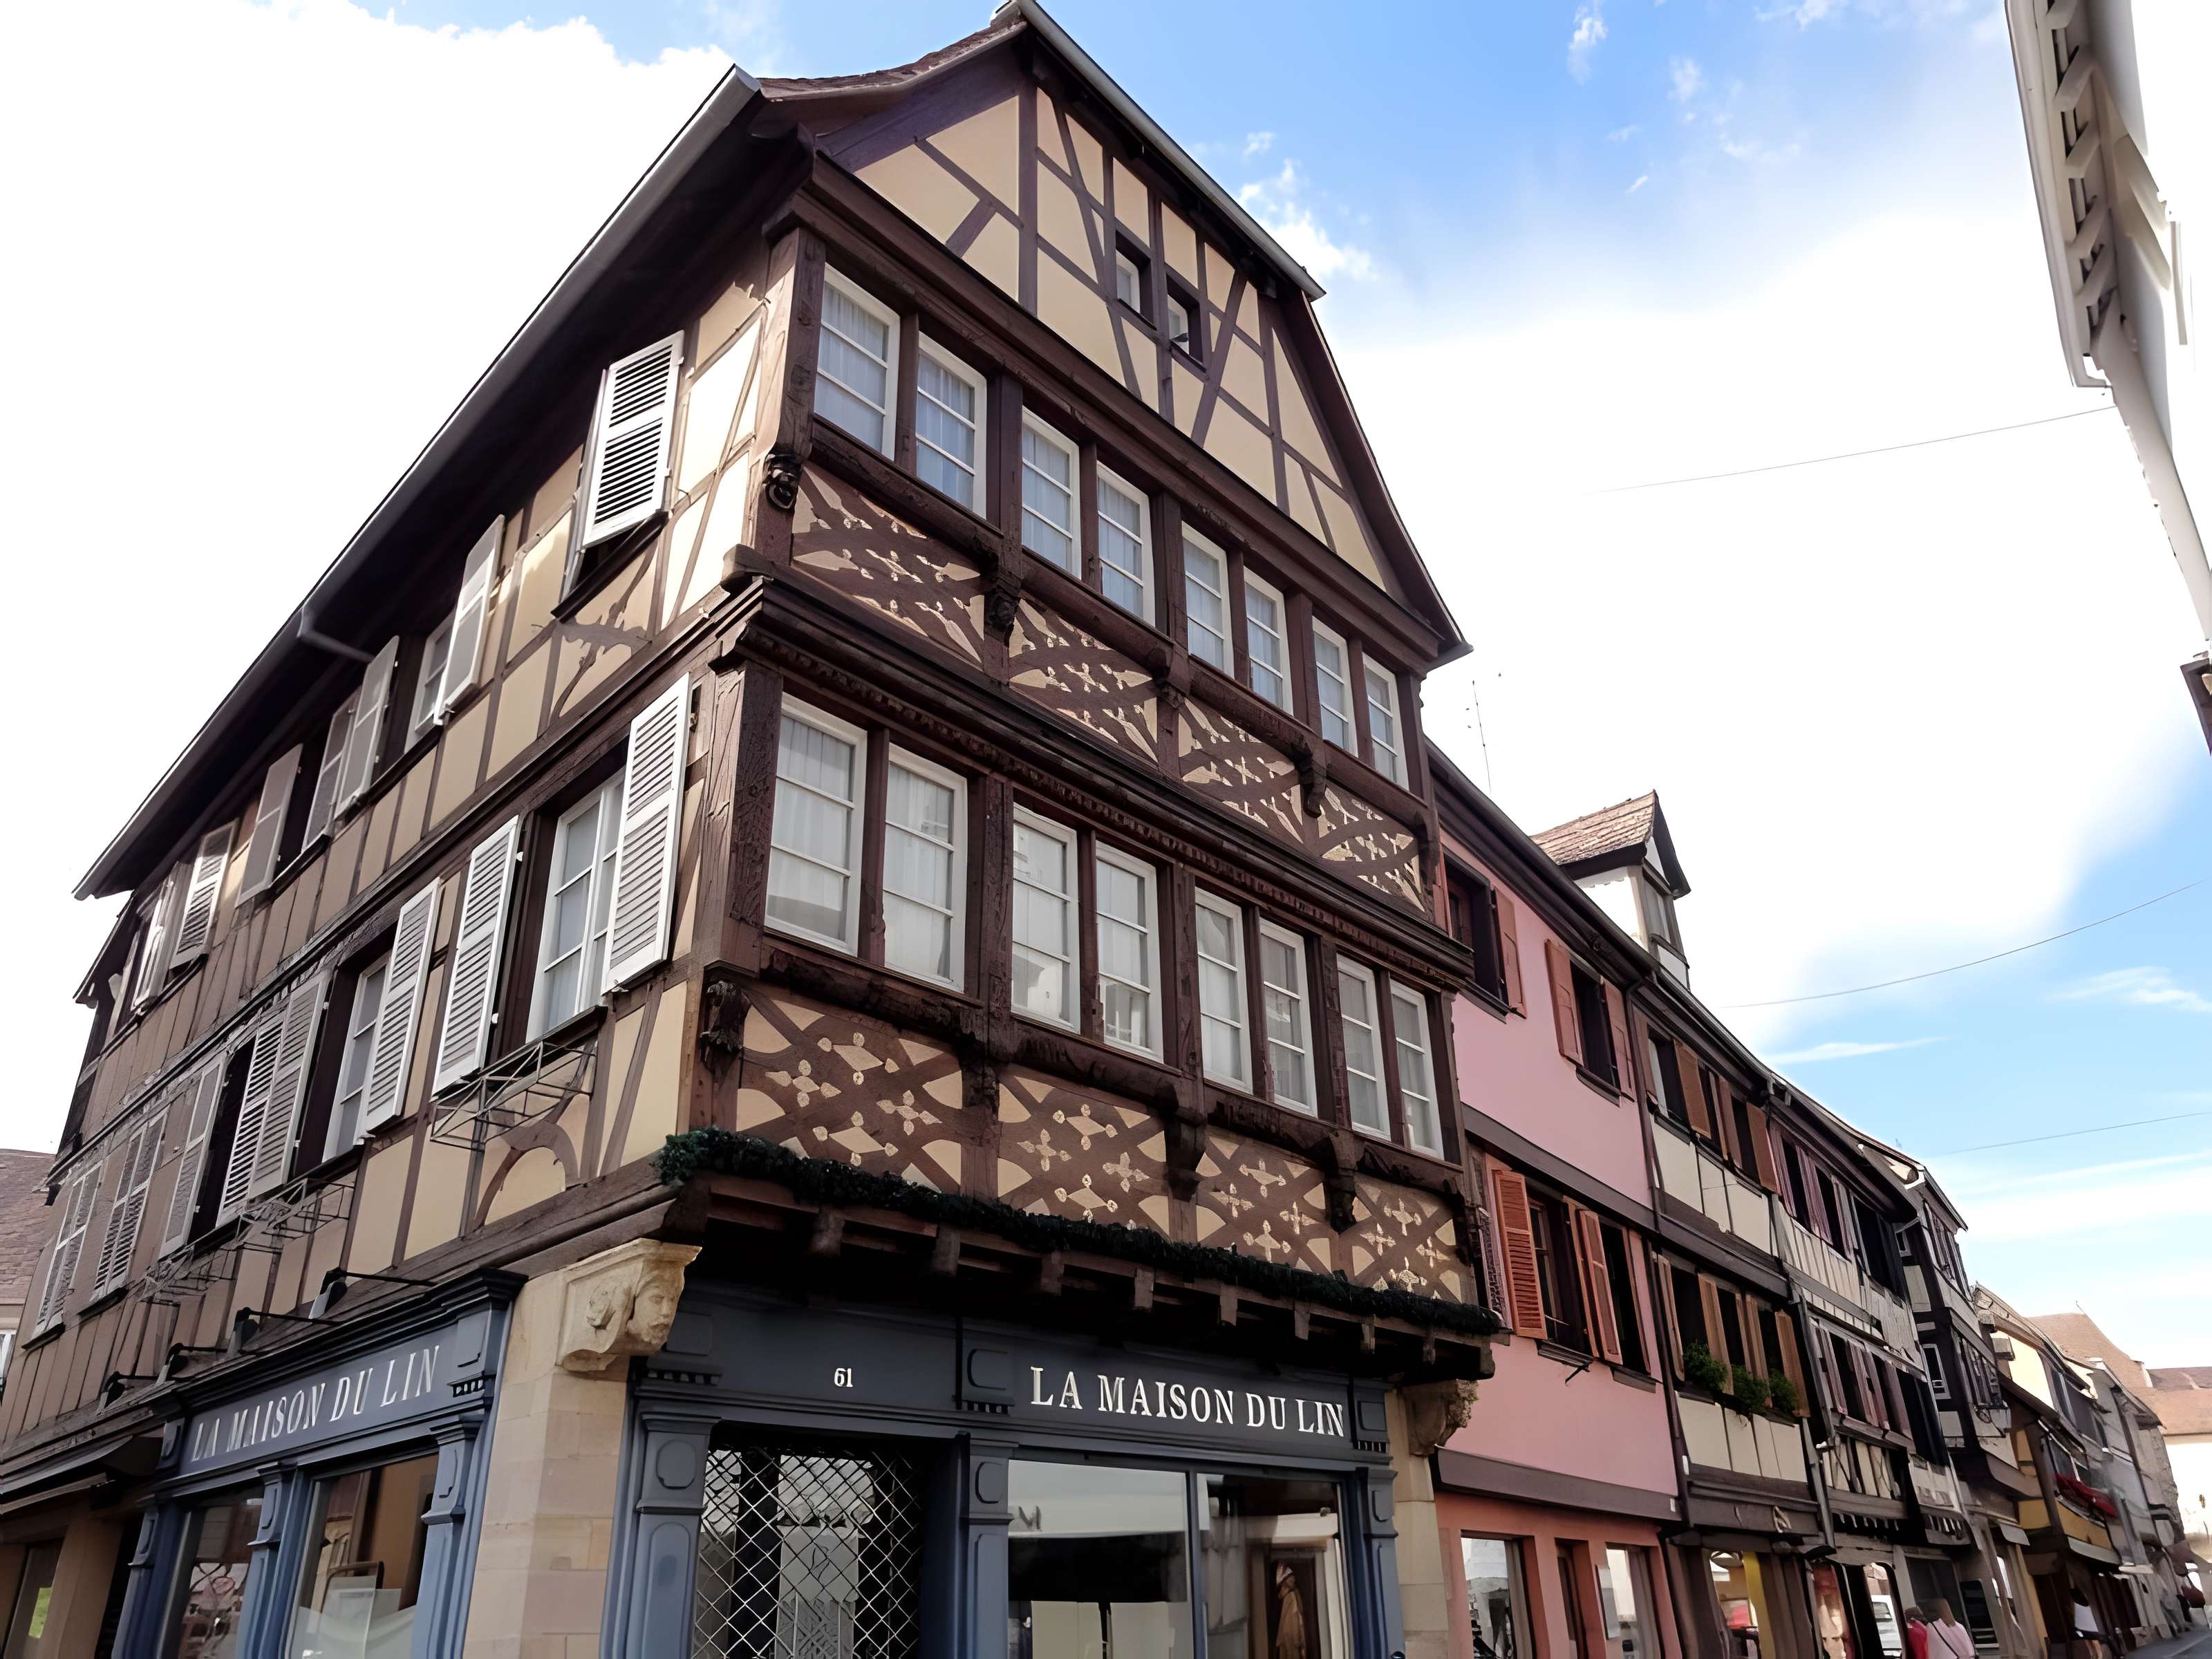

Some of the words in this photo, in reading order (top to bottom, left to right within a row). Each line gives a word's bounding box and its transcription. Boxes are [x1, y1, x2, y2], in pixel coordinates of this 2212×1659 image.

[191, 1418, 220, 1461] LA
[226, 1382, 326, 1452] MAISON
[329, 1367, 374, 1423] DU
[379, 1344, 440, 1407] LIN
[834, 1367, 854, 1387] 61
[1030, 1366, 1083, 1410] LA
[1097, 1374, 1234, 1425] MAISON
[1245, 1392, 1286, 1430] DU
[1295, 1398, 1344, 1437] LIN
